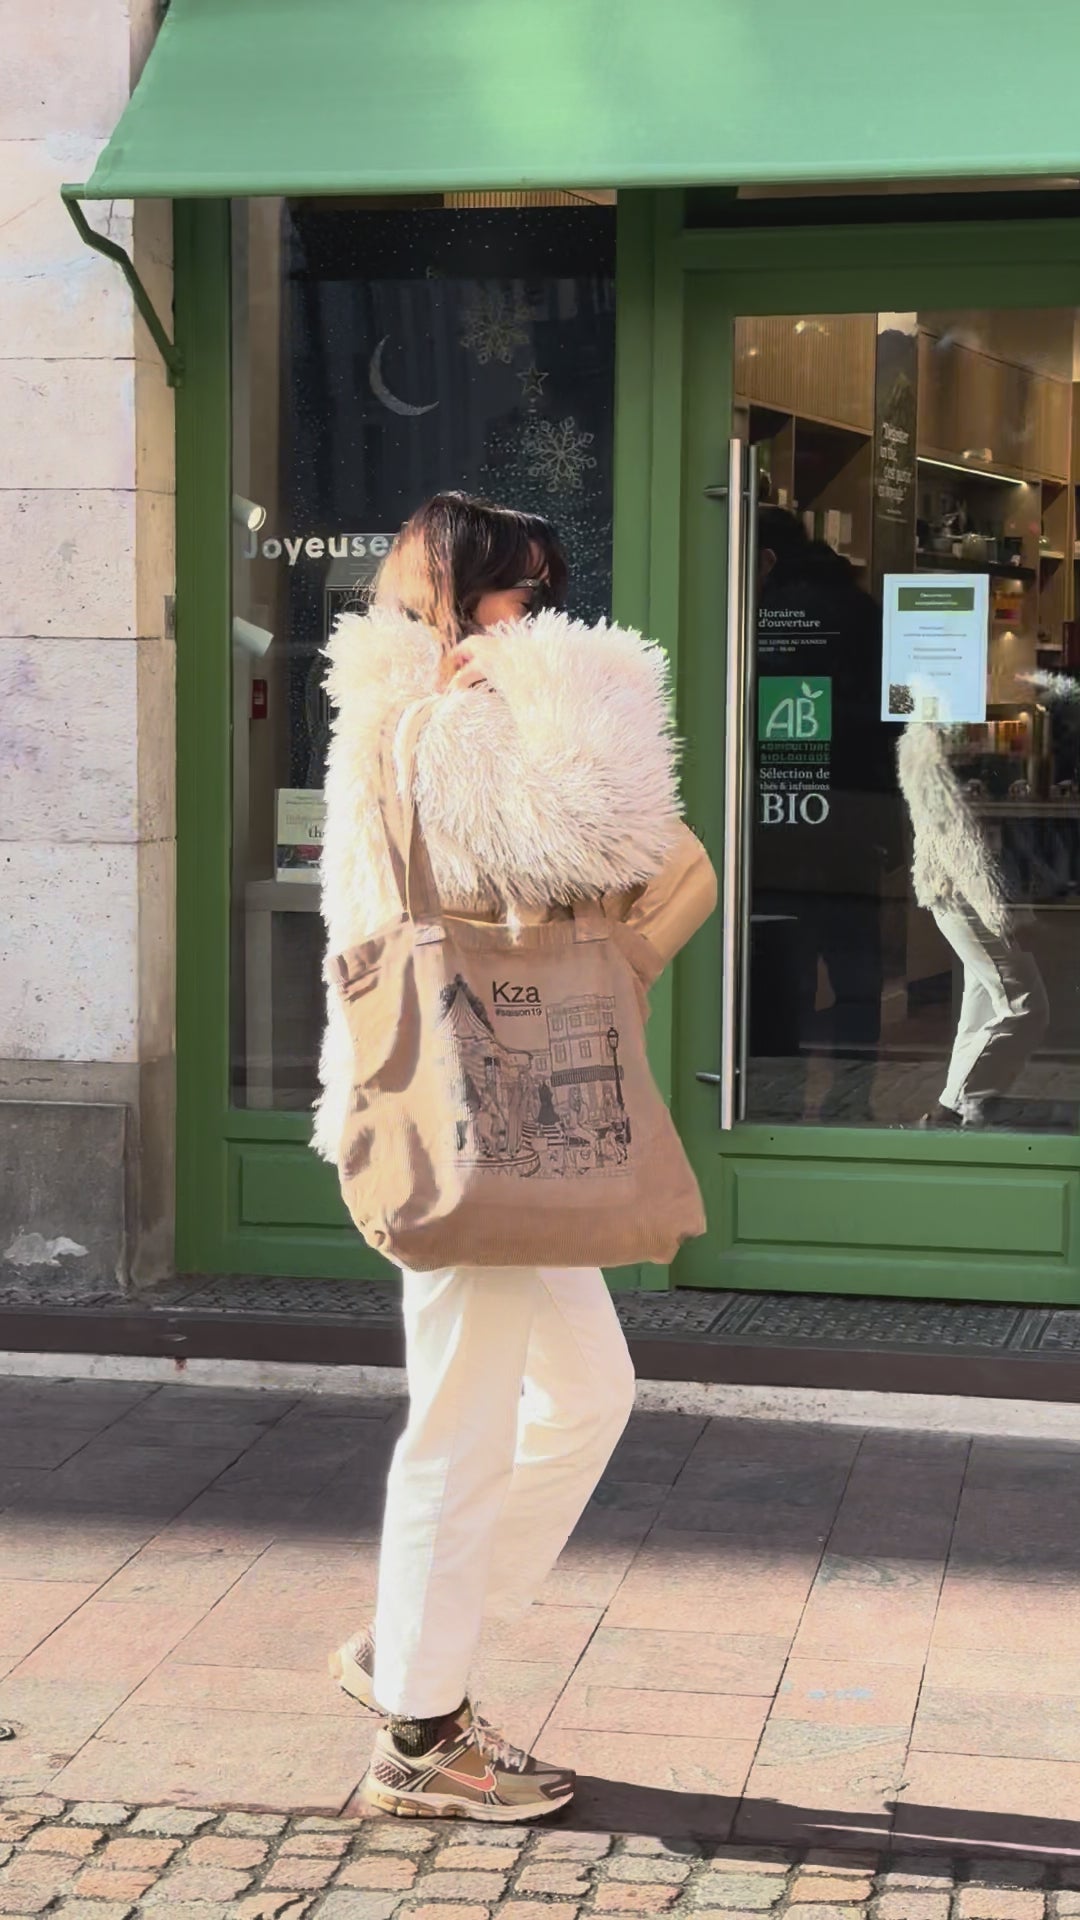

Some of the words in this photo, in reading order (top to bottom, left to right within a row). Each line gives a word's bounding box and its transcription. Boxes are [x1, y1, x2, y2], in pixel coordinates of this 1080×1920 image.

[243, 535, 400, 566] Joyeuse
[759, 608, 806, 618] Horaires
[758, 618, 821, 628] d'ouverture
[765, 698, 818, 738] AB
[760, 767, 813, 779] Sélection
[816, 767, 830, 779] de
[789, 781, 830, 791] infusions
[759, 793, 829, 824] BIO
[492, 981, 541, 1003] Kza
